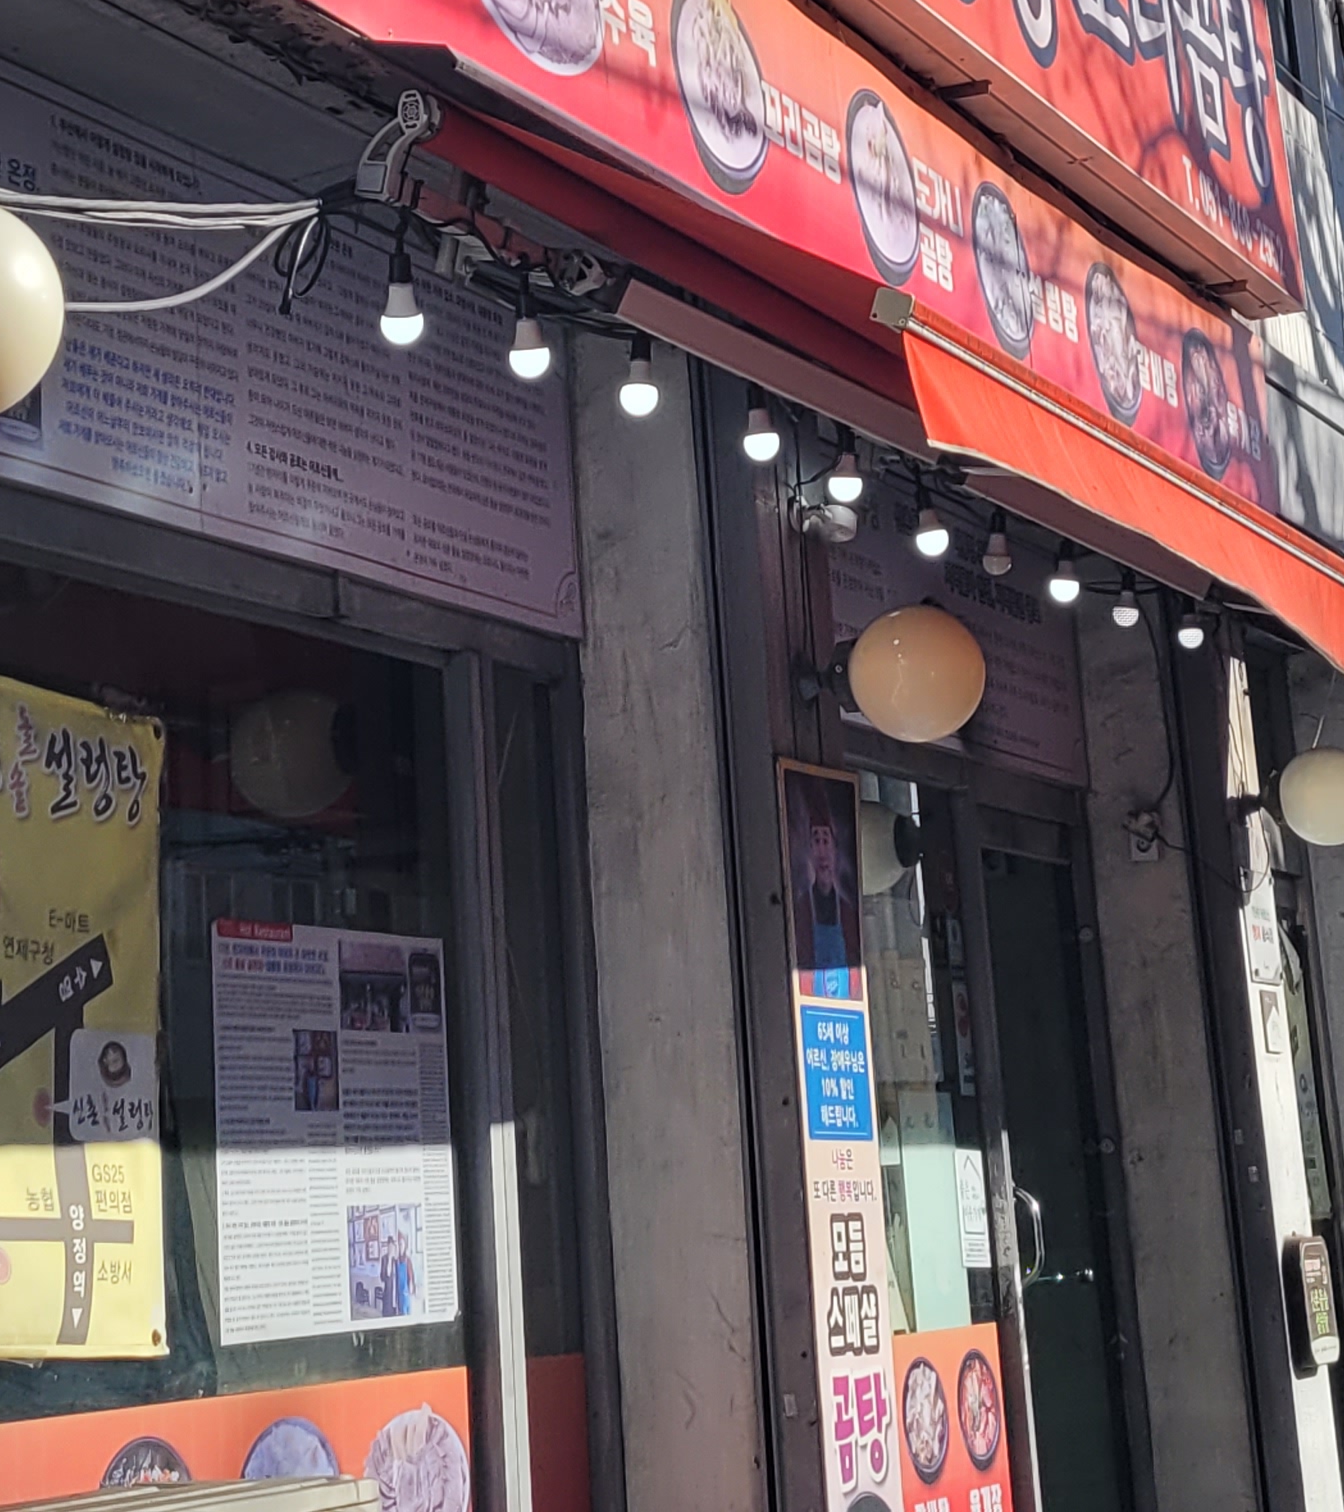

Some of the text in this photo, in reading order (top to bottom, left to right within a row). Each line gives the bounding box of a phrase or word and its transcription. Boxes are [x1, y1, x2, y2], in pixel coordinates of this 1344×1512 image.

[761, 79, 842, 185] 꼬리곰탕
[912, 156, 965, 238] 도가니
[920, 230, 954, 293] 곰탕
[44, 728, 147, 824] 설렁탕
[817, 1021, 849, 1045] 65세 이상
[821, 1077, 855, 1100] 10% 할인
[832, 1148, 854, 1171] 나눔은
[92, 1163, 125, 1185] GS25
[26, 1187, 54, 1212] 농협
[94, 1189, 134, 1216] 편의점
[813, 1180, 821, 1199] 또
[822, 1180, 837, 1202] 다른
[69, 1204, 87, 1299] 양정역
[830, 1213, 867, 1281] 모듬
[97, 1260, 133, 1286] 소방서
[830, 1369, 890, 1488] 곰탕
